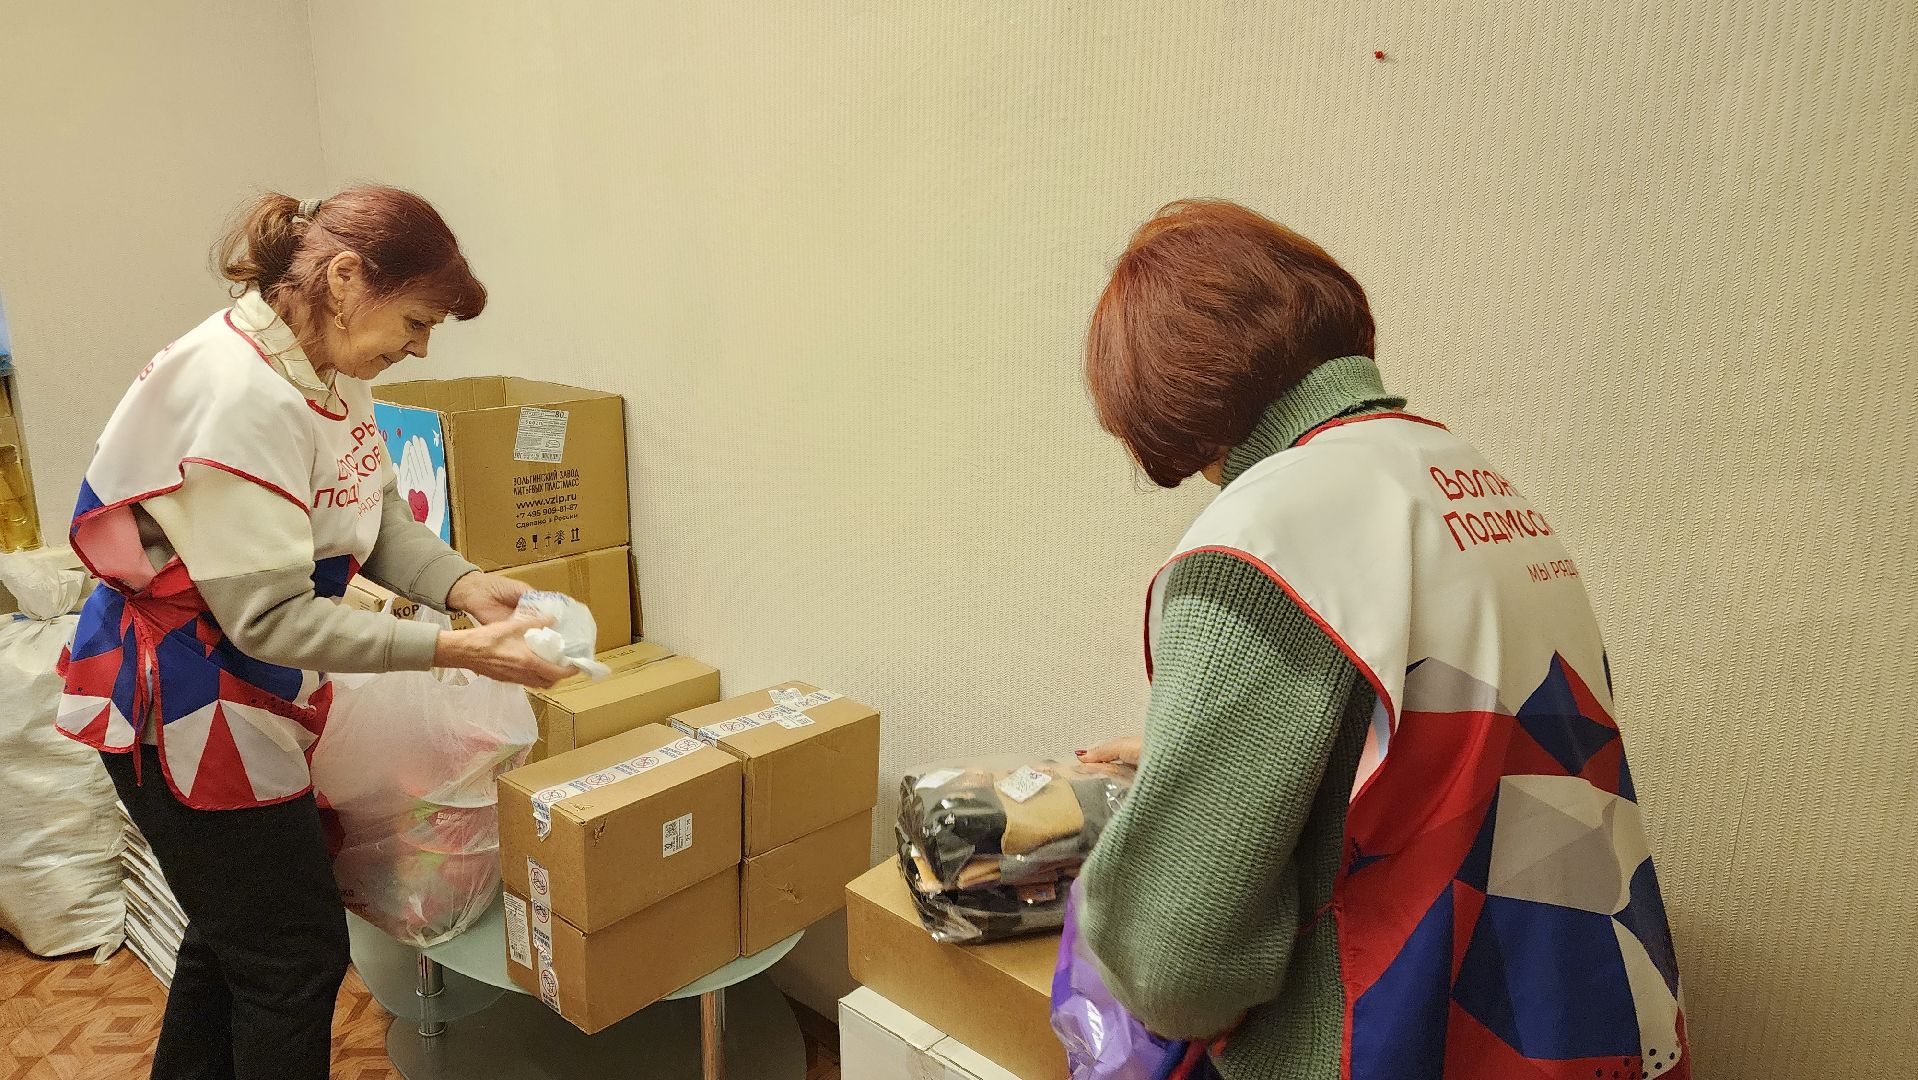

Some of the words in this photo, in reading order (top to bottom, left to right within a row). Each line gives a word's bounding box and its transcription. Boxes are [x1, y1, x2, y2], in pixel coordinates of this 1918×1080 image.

[559, 468, 580, 480] ЗАВОД
[544, 477, 580, 493] ПЛАСТМАСС
[516, 493, 577, 510] www.vzlp.ru
[515, 511, 526, 519] +7
[527, 509, 541, 518] 495
[515, 518, 547, 529] Сделано
[1526, 562, 1552, 583] МЫ
